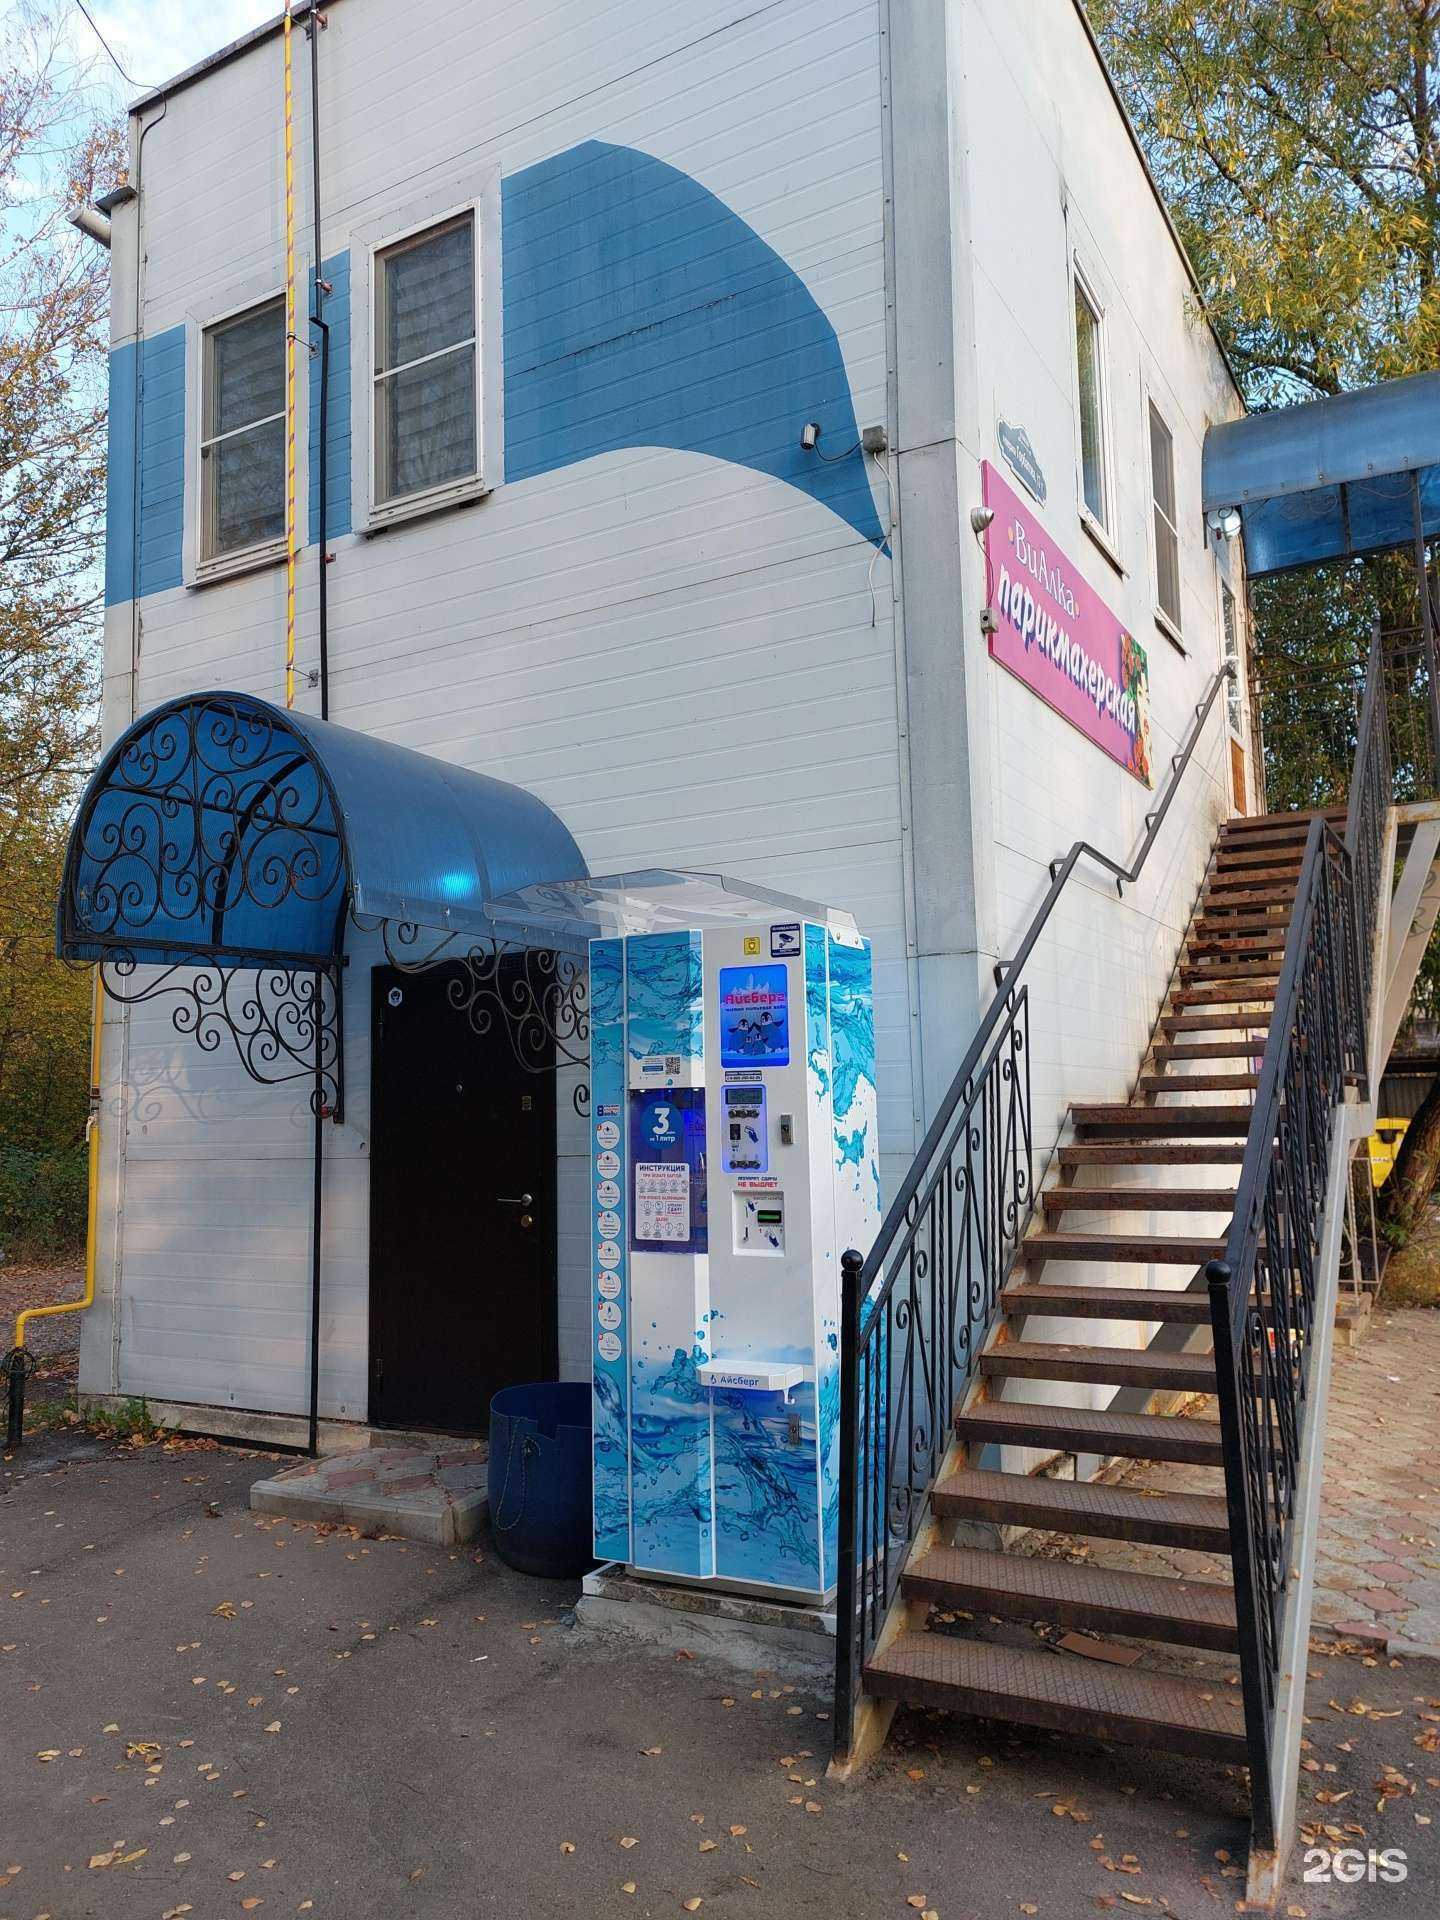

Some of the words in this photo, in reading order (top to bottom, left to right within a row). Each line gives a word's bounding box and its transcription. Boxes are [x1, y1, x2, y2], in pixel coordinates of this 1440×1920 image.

[998, 564, 1135, 733] парикмахерская
[652, 1107, 670, 1135] 3
[639, 1165, 685, 1173] ИНСТРУКЦИЯ
[720, 1375, 760, 1387] Айсберг
